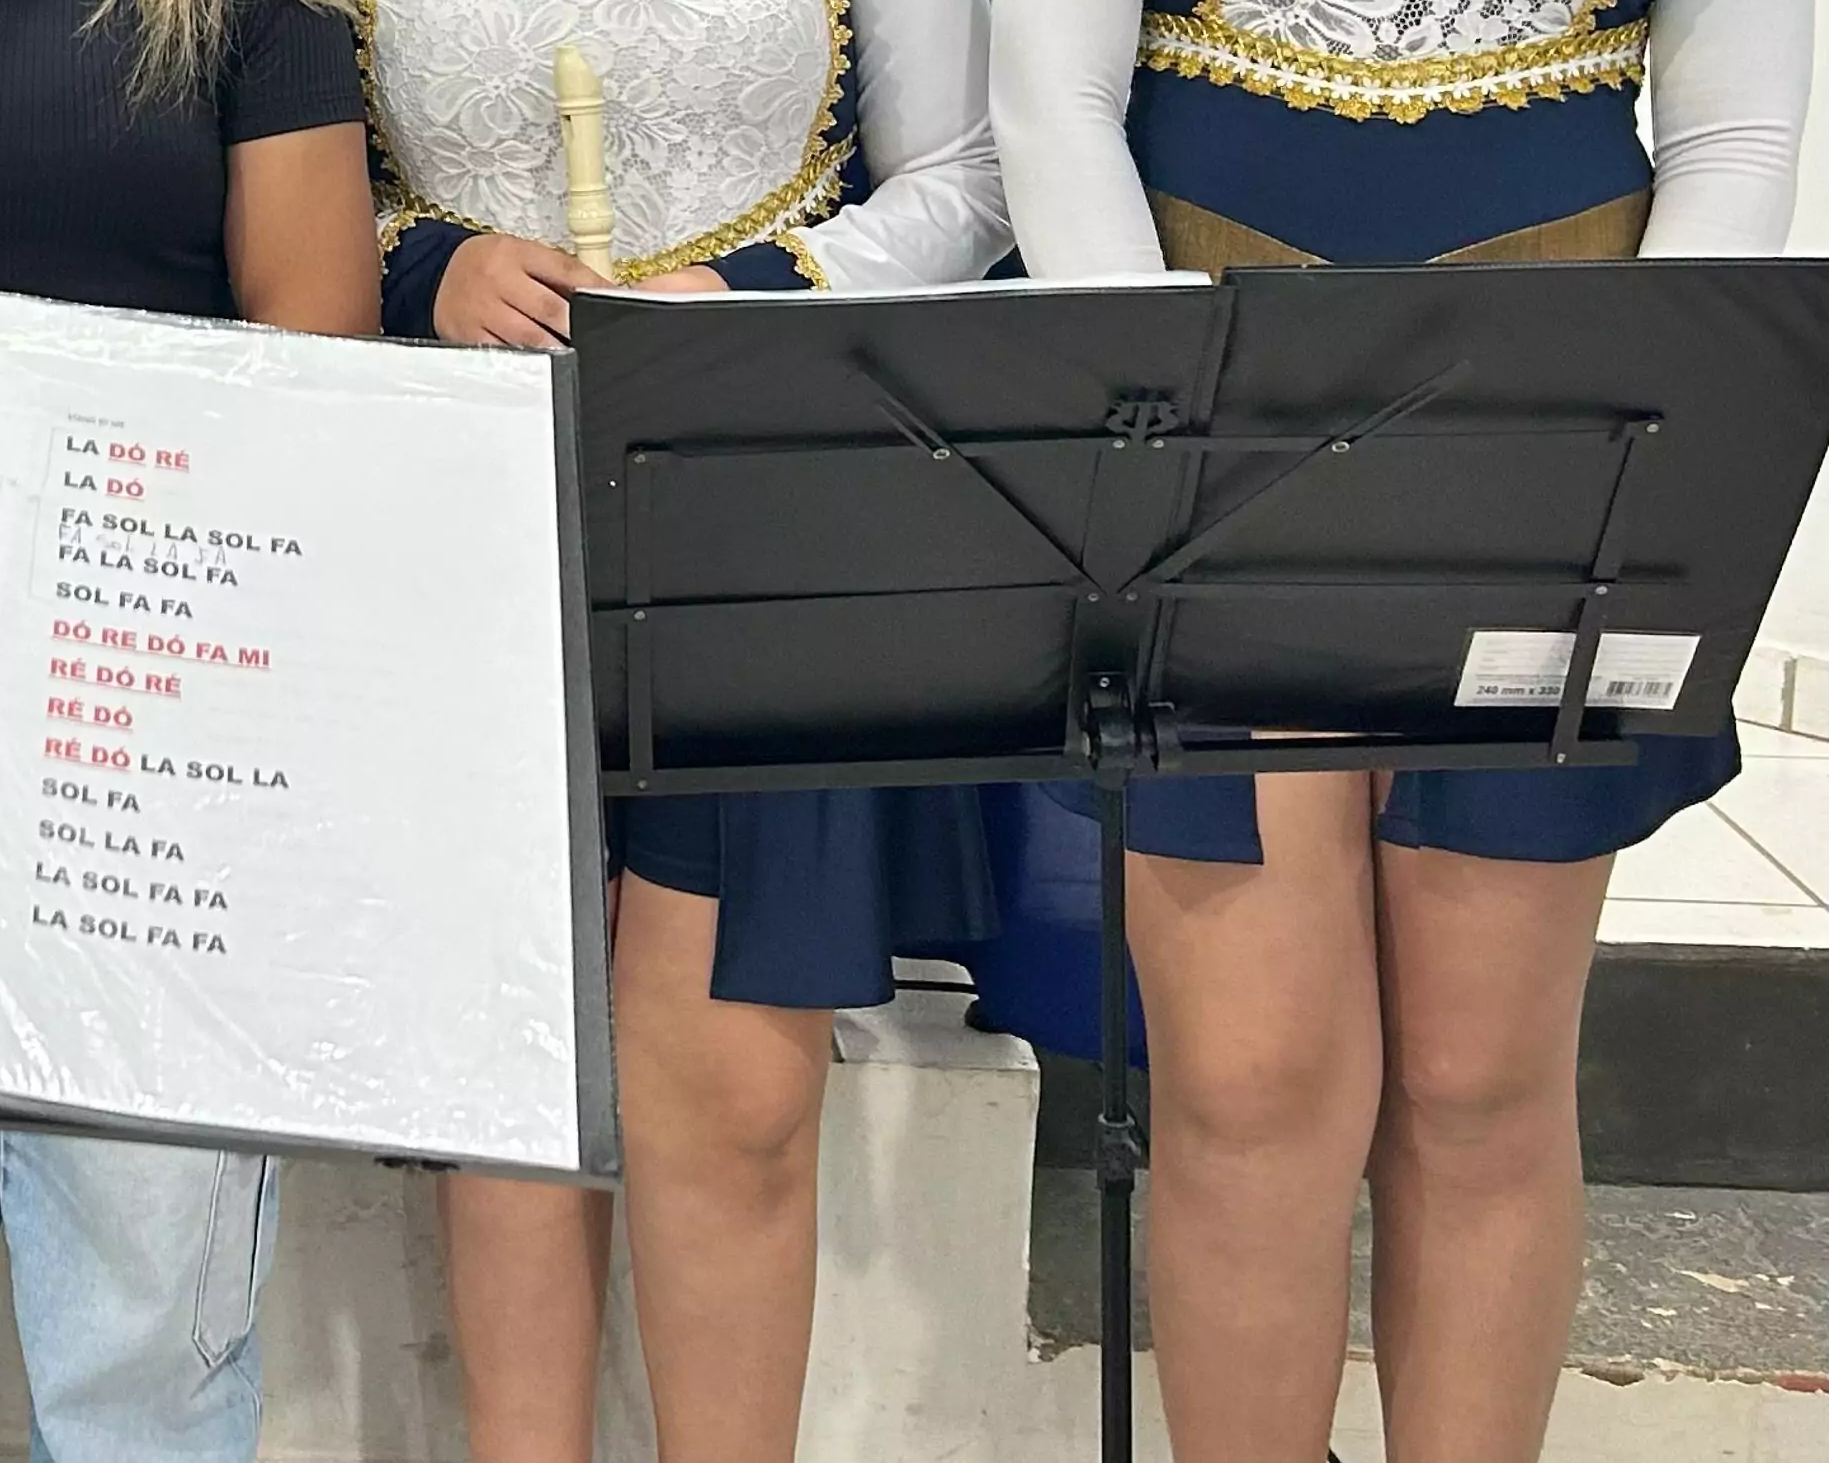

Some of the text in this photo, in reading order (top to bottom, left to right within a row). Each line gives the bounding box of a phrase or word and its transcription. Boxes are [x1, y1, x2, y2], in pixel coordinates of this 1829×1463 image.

[66, 436, 190, 468] LA DÓ RÉ
[64, 472, 145, 497] LA DÓ
[61, 508, 303, 556] FA SOL LA SOL FA
[59, 545, 238, 586] FA LA SOL FA
[56, 581, 193, 618] SOL FA FA
[53, 619, 91, 639] DÓ
[148, 634, 185, 655] DÓ
[196, 642, 228, 661] FA
[238, 647, 270, 666] MI
[51, 657, 181, 694] RÉ DÓ RÉ
[48, 696, 133, 727] RÉ DÓ
[45, 737, 290, 789] RÉ DÓ LA SOL LA
[41, 778, 141, 813] SOL FA
[38, 819, 185, 862] SOL LA FA
[35, 861, 228, 910] LA SOL FA FA
[32, 905, 227, 954] LA SOL FA FA
